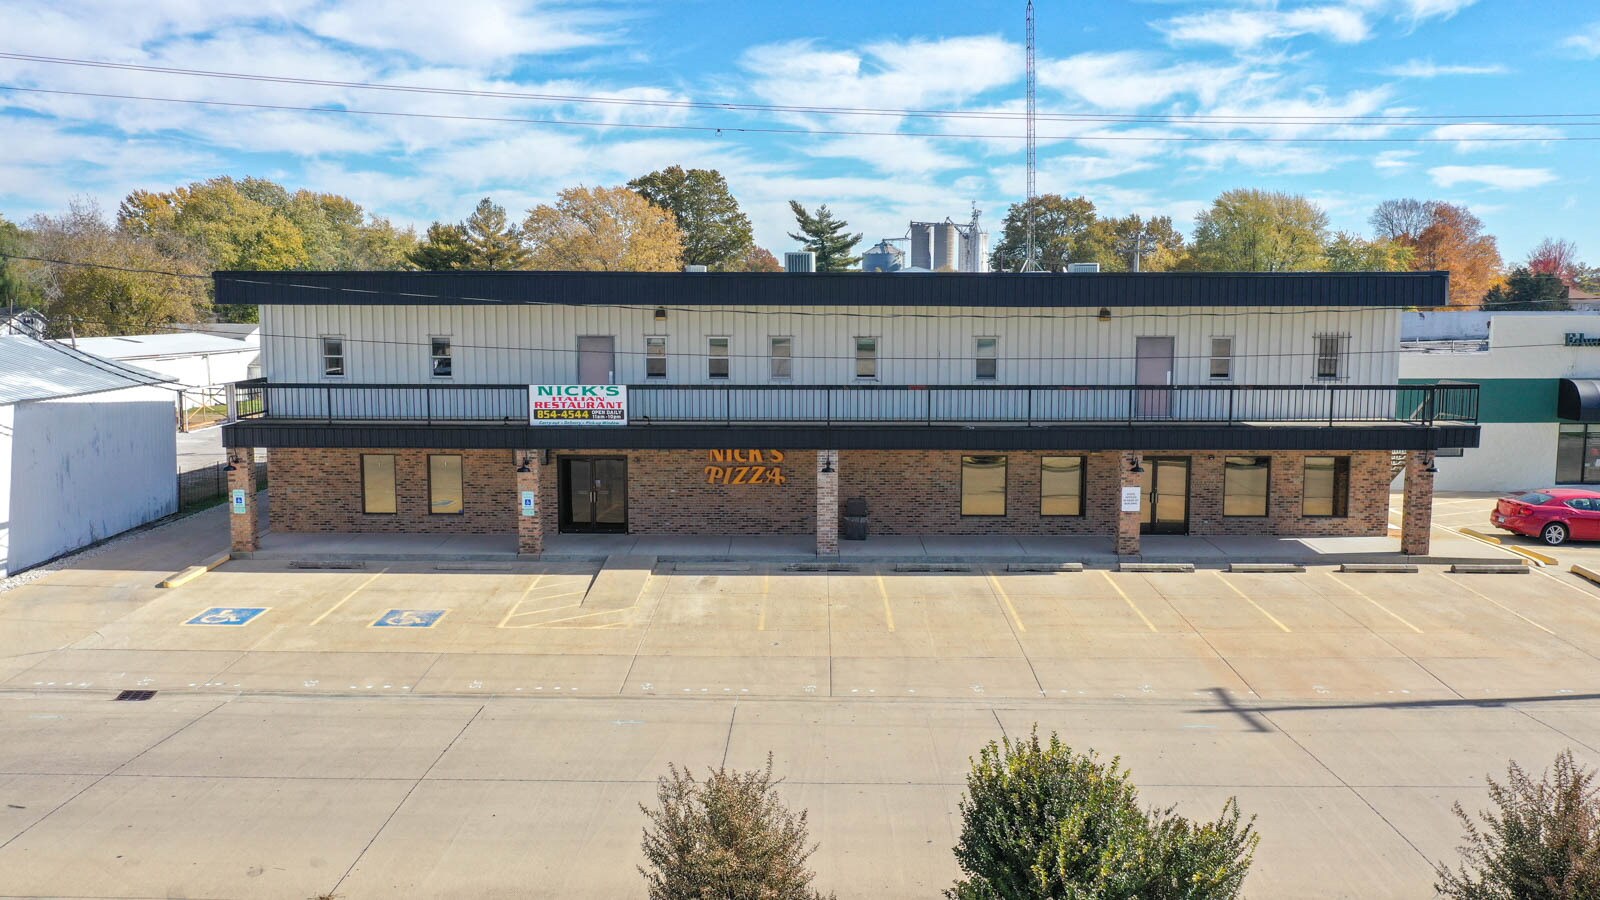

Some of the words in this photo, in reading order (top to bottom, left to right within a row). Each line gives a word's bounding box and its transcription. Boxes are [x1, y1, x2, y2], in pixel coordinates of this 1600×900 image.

[538, 386, 620, 396] NICK'S
[537, 410, 590, 419] 854-4544
[709, 449, 785, 463] NICKS
[704, 466, 786, 486] PIZZA
